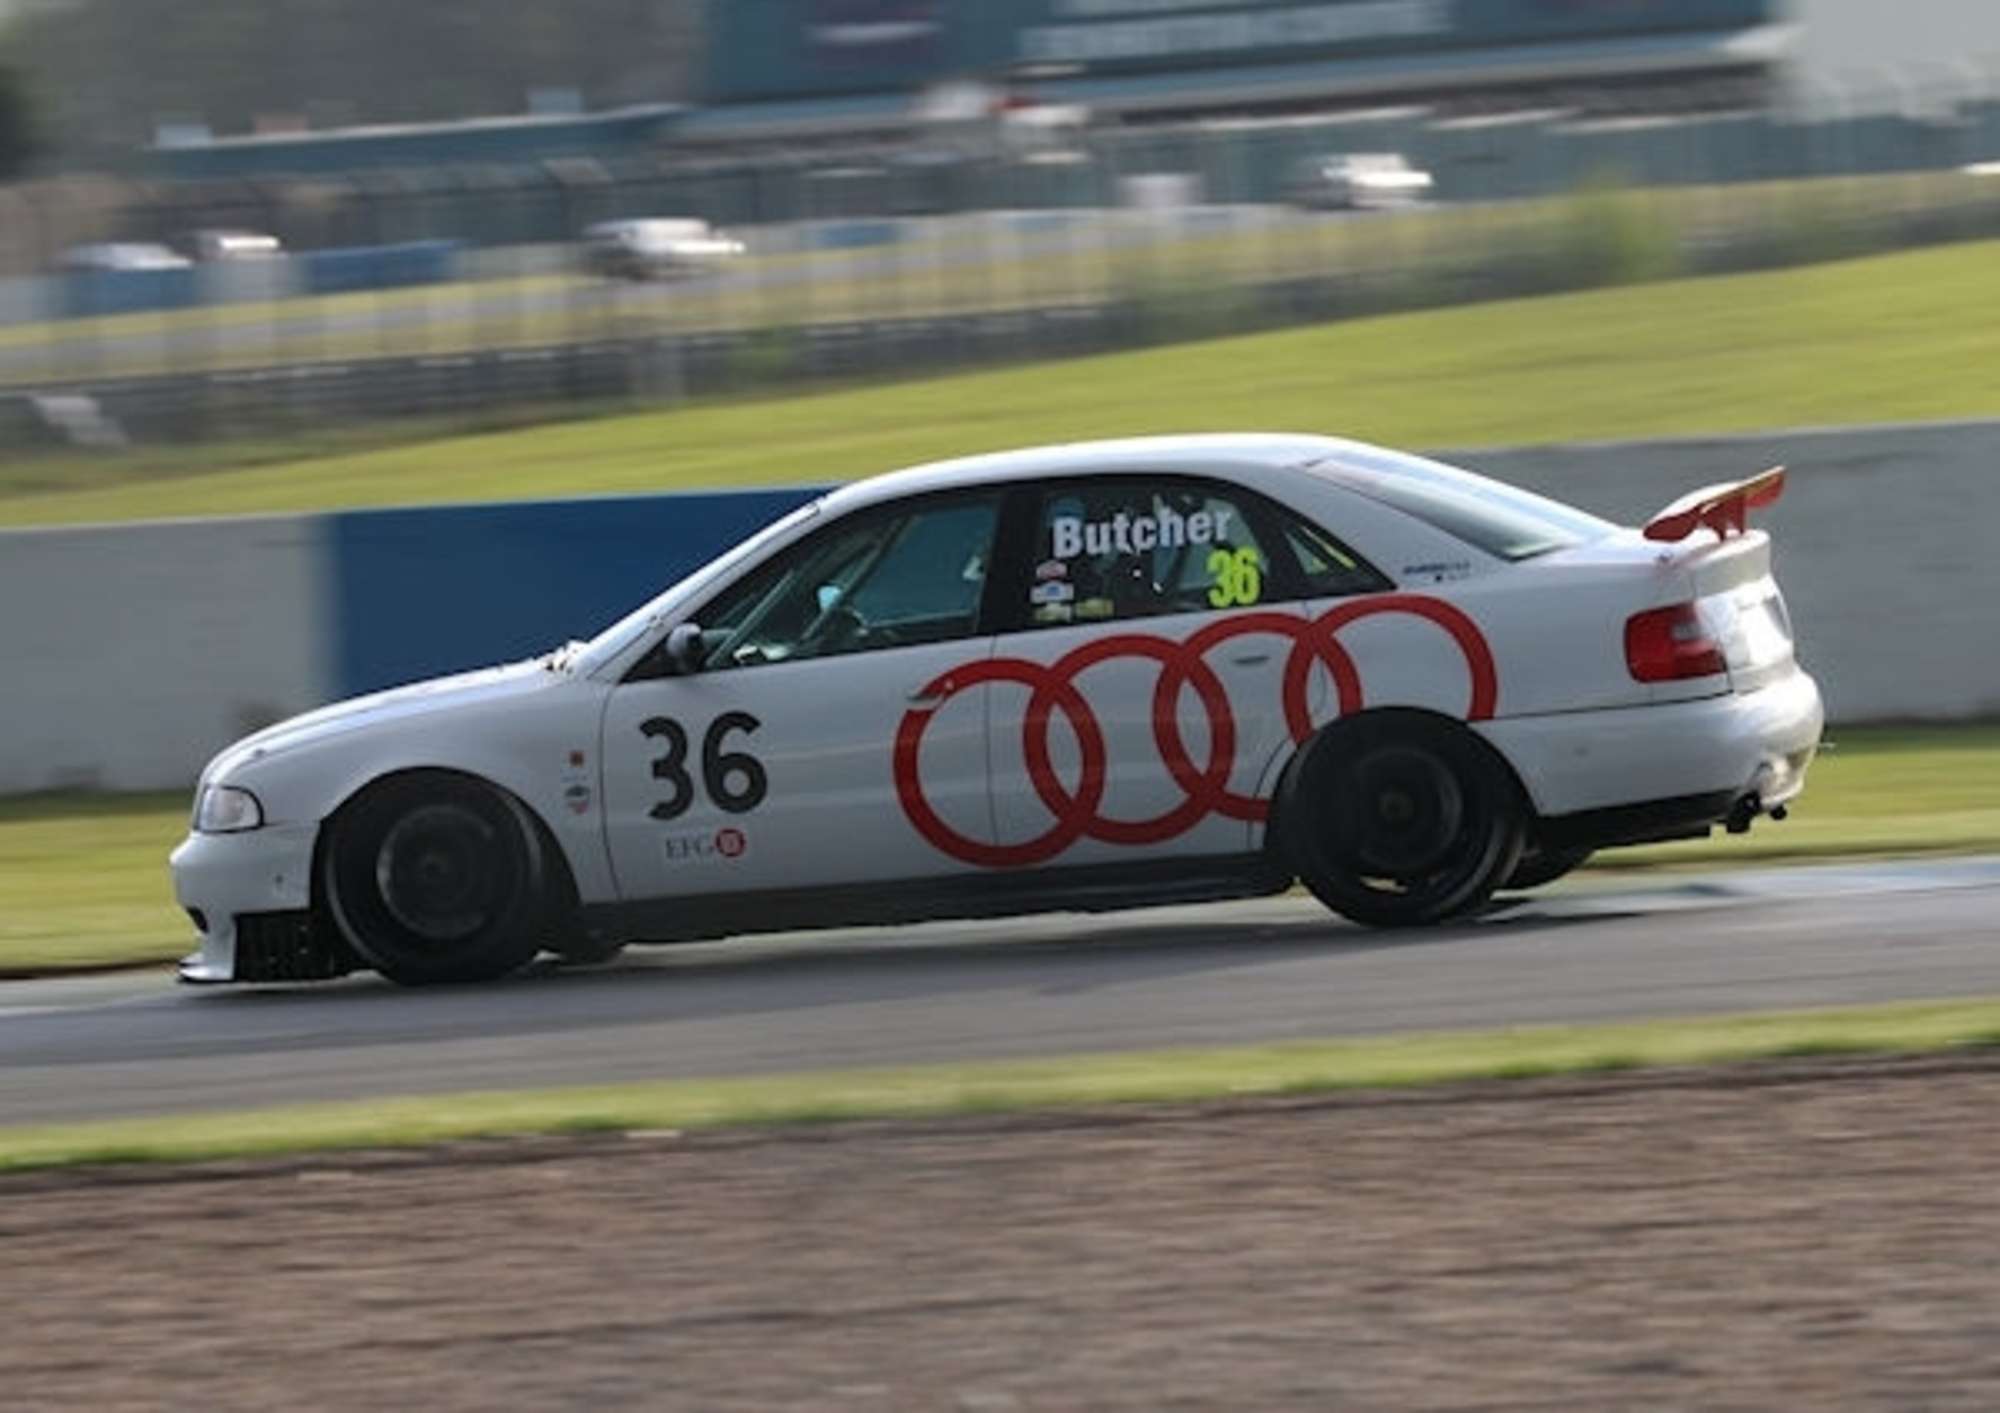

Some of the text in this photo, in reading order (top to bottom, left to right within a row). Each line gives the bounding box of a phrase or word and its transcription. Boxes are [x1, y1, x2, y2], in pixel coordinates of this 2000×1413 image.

[1053, 507, 1231, 558] Butcher
[1206, 545, 1261, 608] 36
[639, 710, 768, 820] 36
